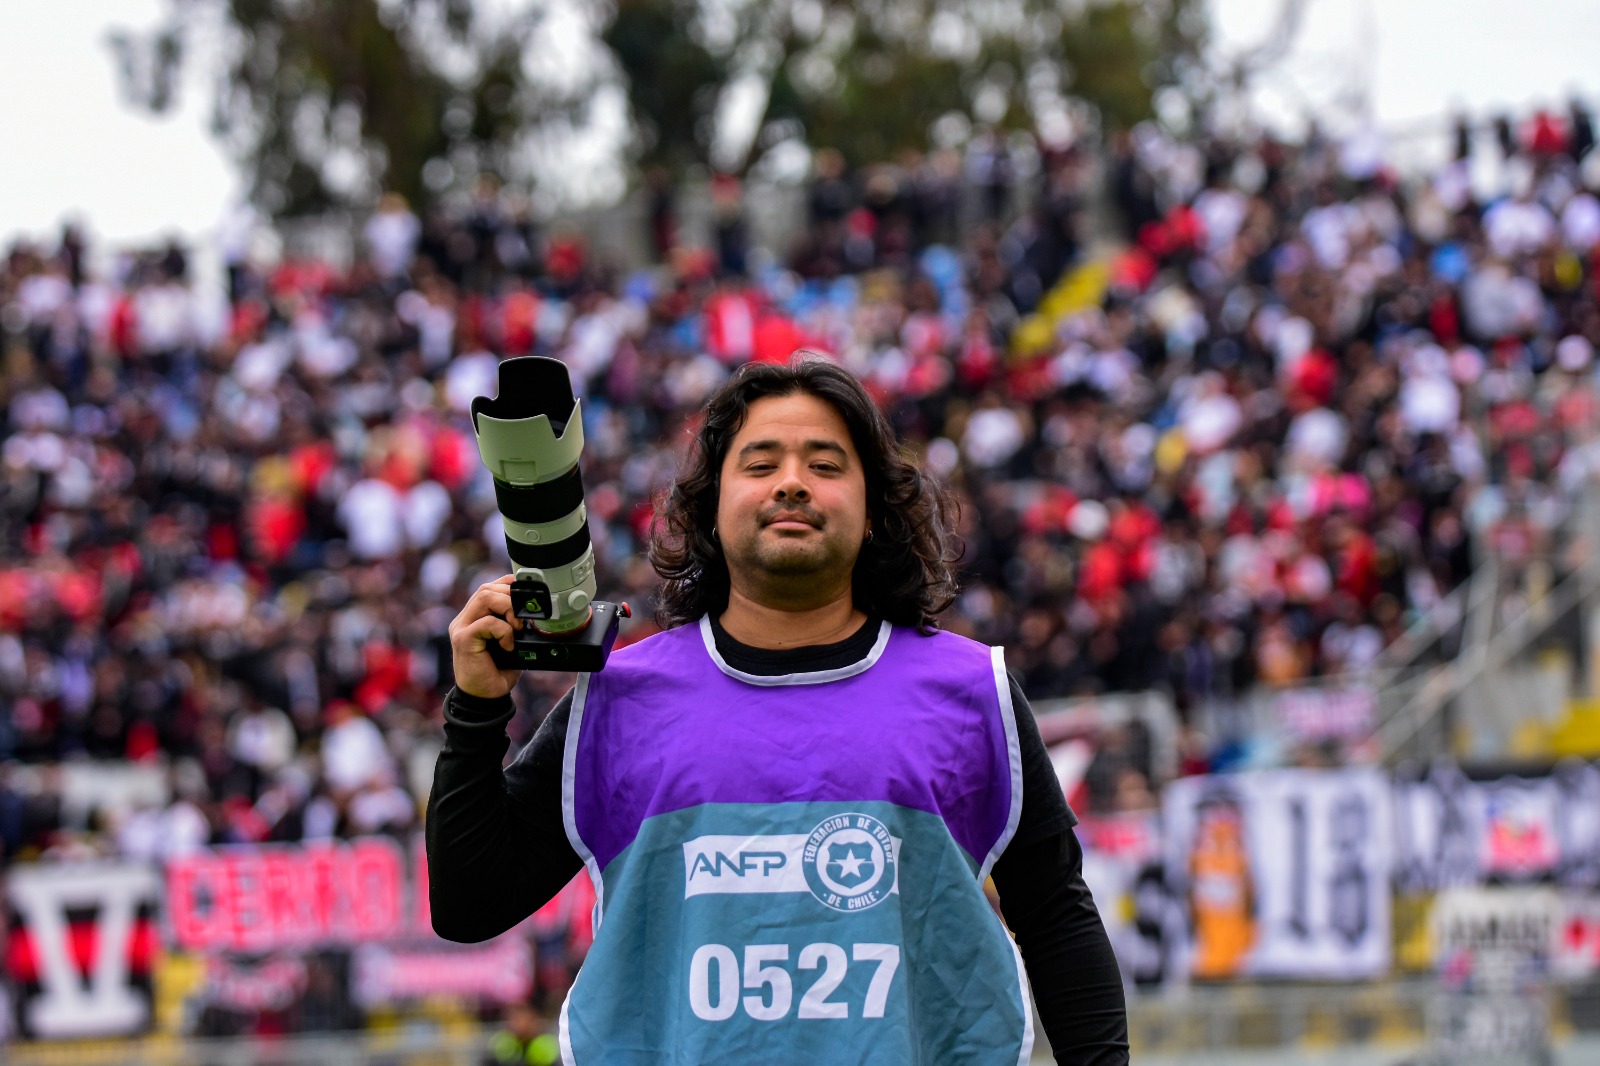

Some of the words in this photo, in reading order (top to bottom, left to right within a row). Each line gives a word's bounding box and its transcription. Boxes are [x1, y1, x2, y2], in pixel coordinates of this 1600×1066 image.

[804, 816, 850, 863] FEDERACION
[857, 817, 871, 829] DE
[689, 851, 787, 881] ANFP
[827, 894, 842, 907] DE
[848, 891, 877, 909] CHILE
[689, 943, 900, 1021] 0527
